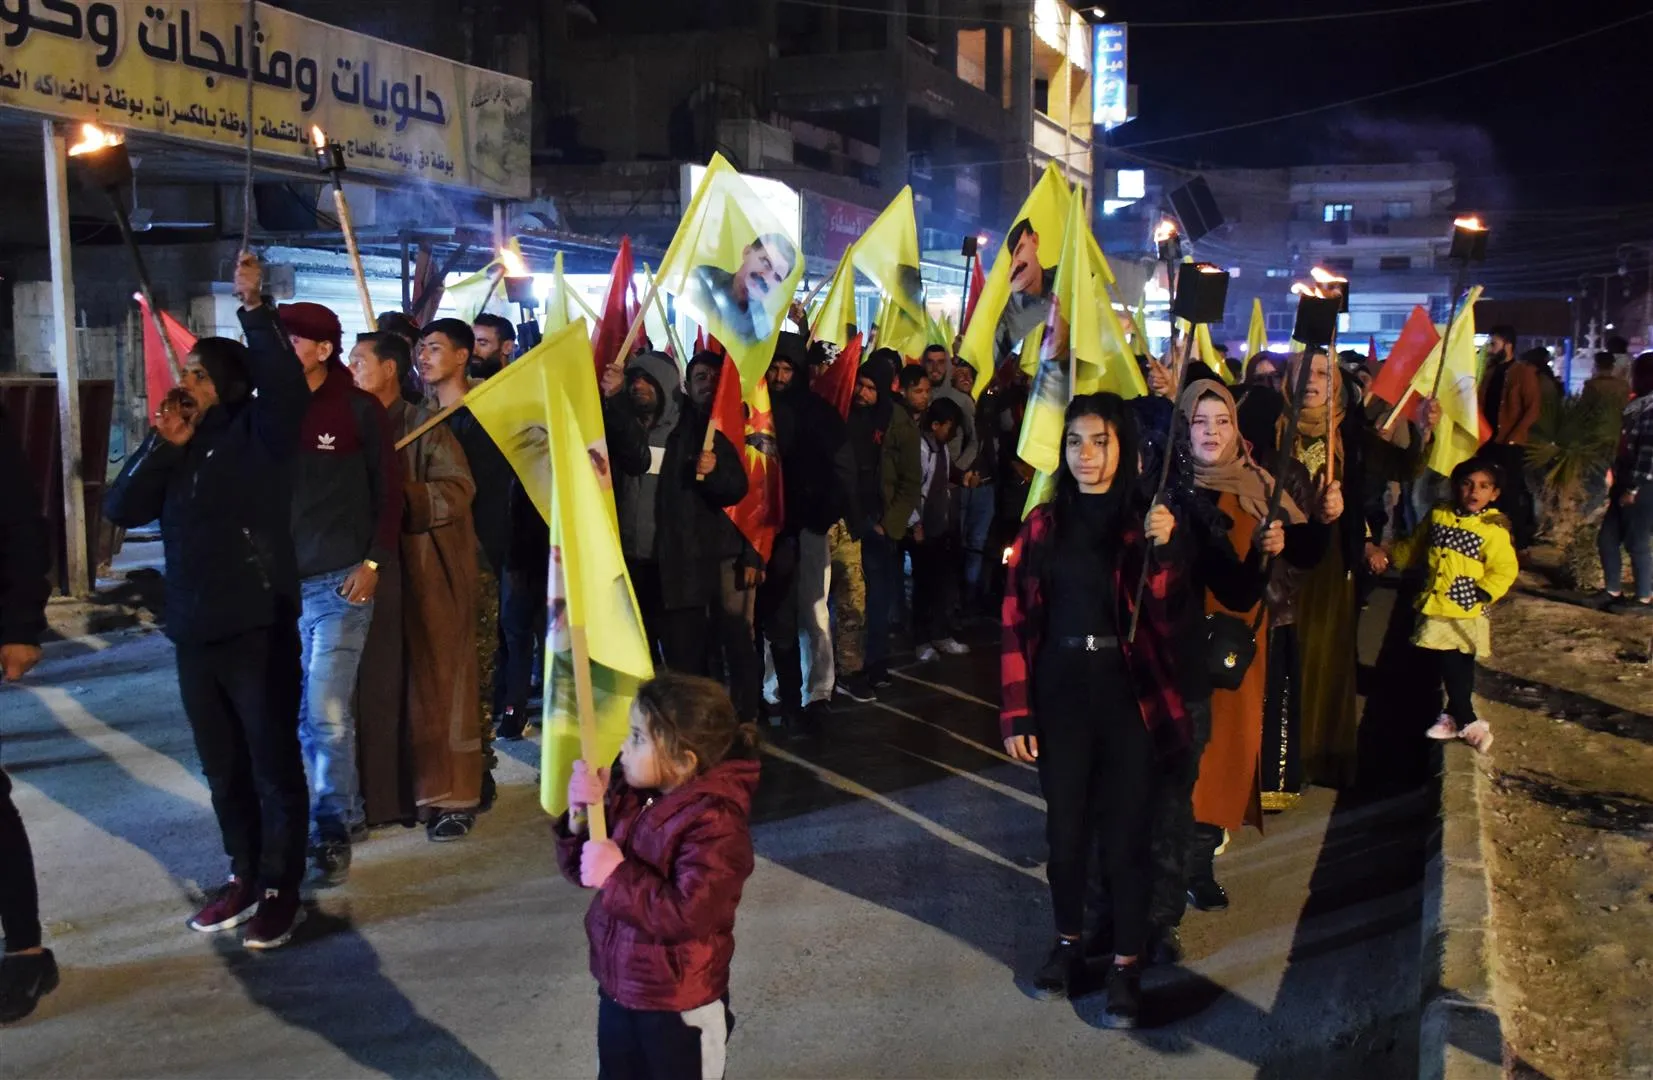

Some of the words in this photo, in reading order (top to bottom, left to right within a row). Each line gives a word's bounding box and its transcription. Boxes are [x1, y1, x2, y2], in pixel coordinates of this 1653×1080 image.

[138, 5, 317, 113] ومثلجات
[104, 83, 143, 120] بوظة
[331, 57, 446, 132] حلويات
[219, 107, 252, 139] وظة
